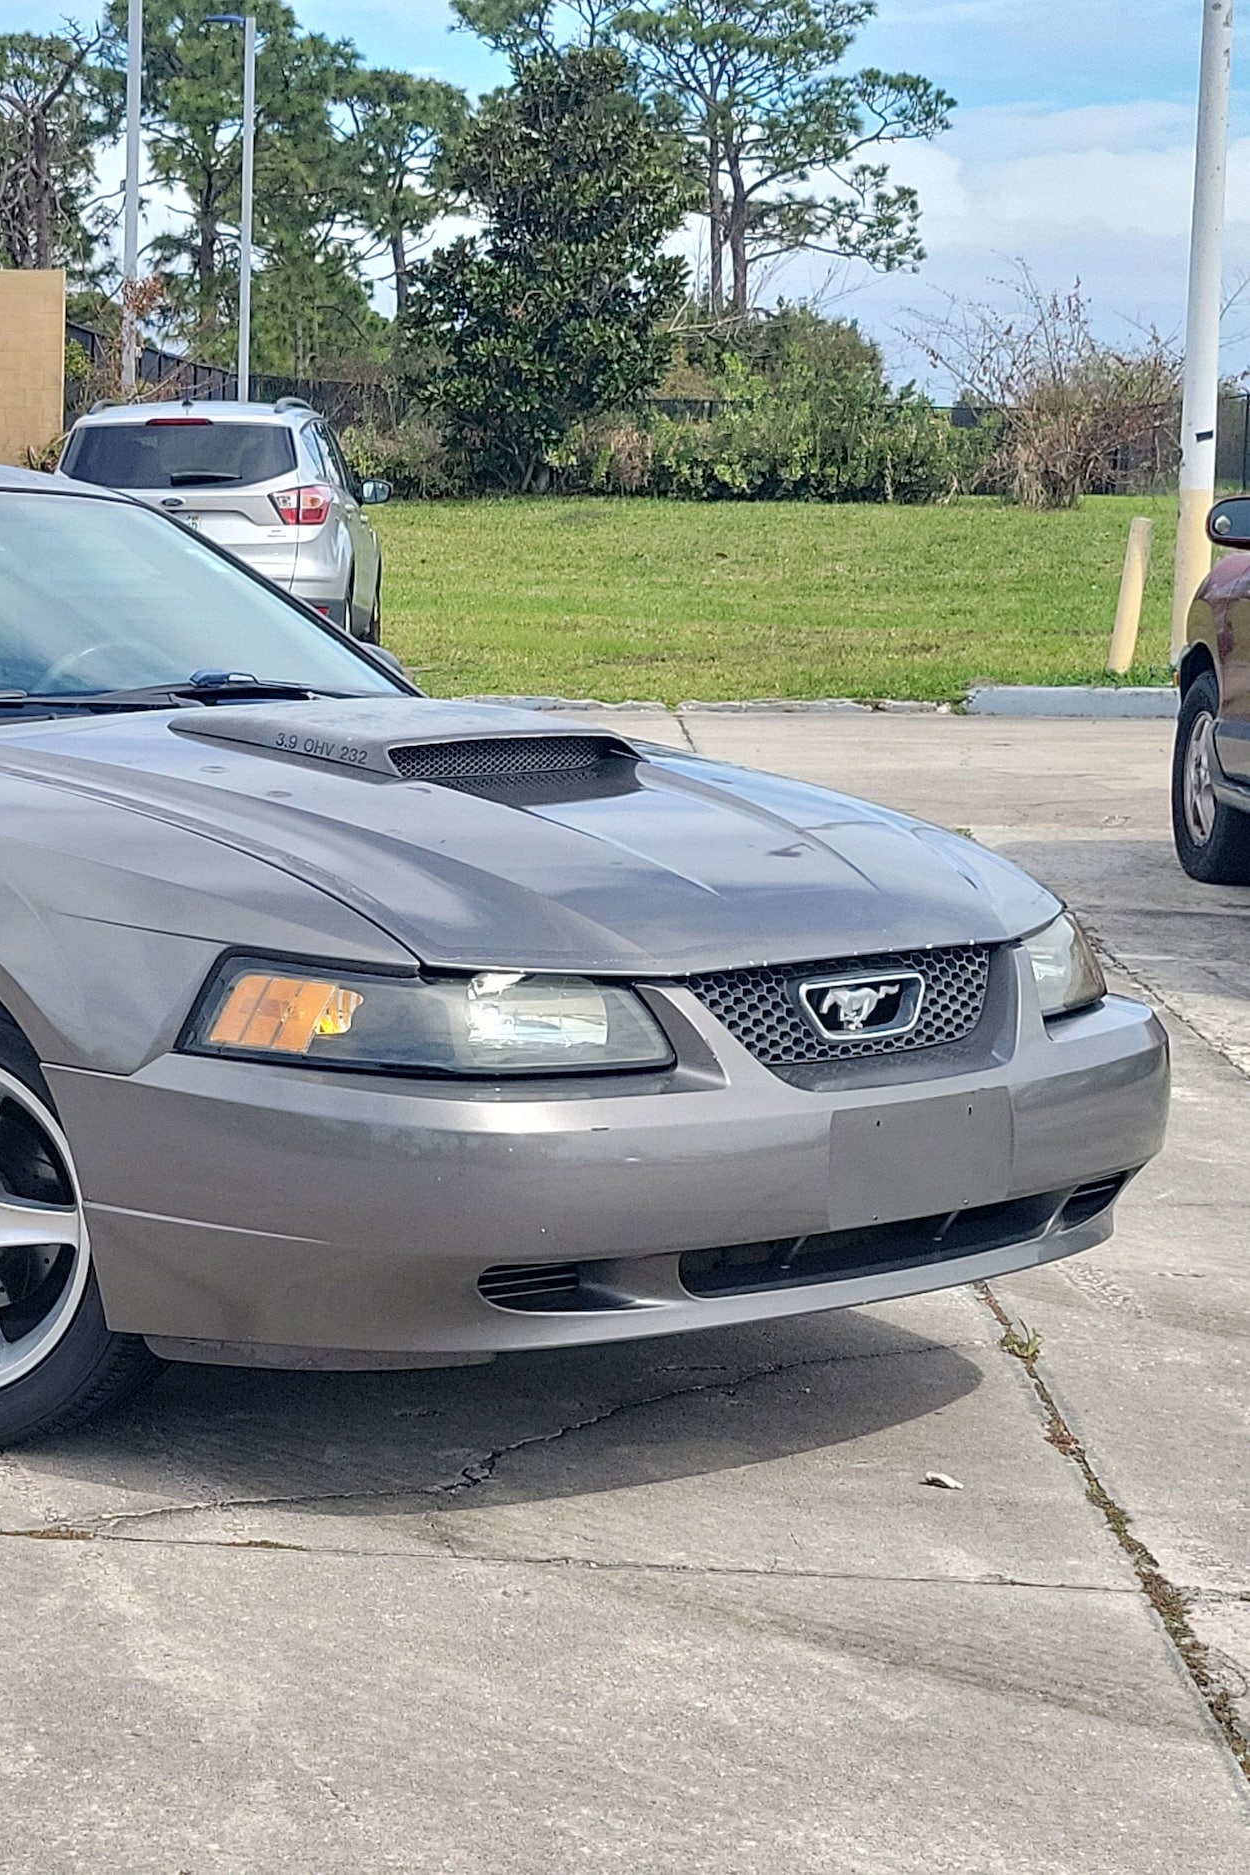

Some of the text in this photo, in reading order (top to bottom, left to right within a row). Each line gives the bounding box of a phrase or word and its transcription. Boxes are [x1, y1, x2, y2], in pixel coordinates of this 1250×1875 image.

[275, 732, 368, 765] 3.9 OHV 232
